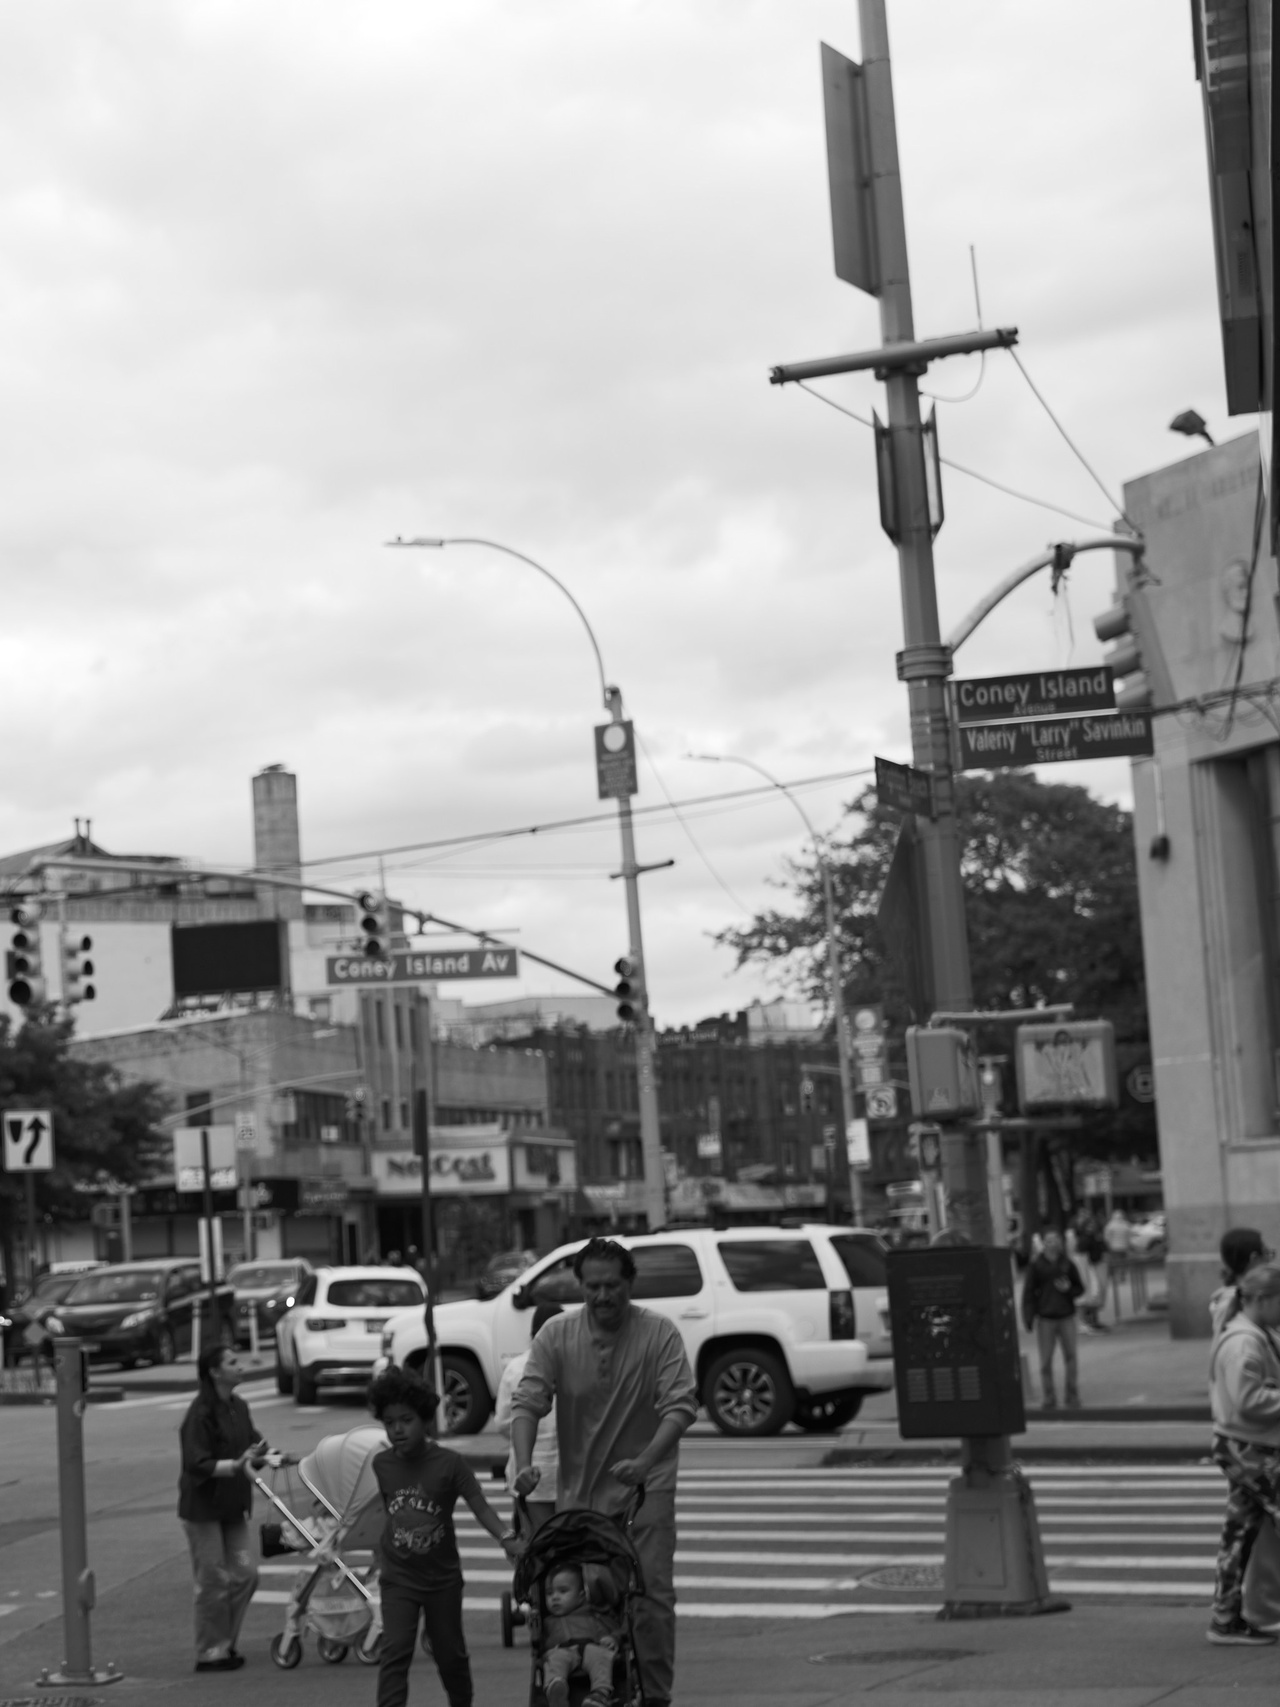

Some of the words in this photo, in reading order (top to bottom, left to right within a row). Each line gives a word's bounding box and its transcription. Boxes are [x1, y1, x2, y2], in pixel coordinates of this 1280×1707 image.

[960, 682, 1030, 706] Coney
[1040, 670, 1107, 698] Island
[1012, 702, 1057, 715] Avenue
[966, 726, 1017, 754] Valeriy
[1082, 715, 1146, 742] Savinkin
[1036, 747, 1079, 761] Street
[334, 958, 397, 980] Coney
[406, 954, 470, 975] Island
[481, 952, 510, 972] Av
